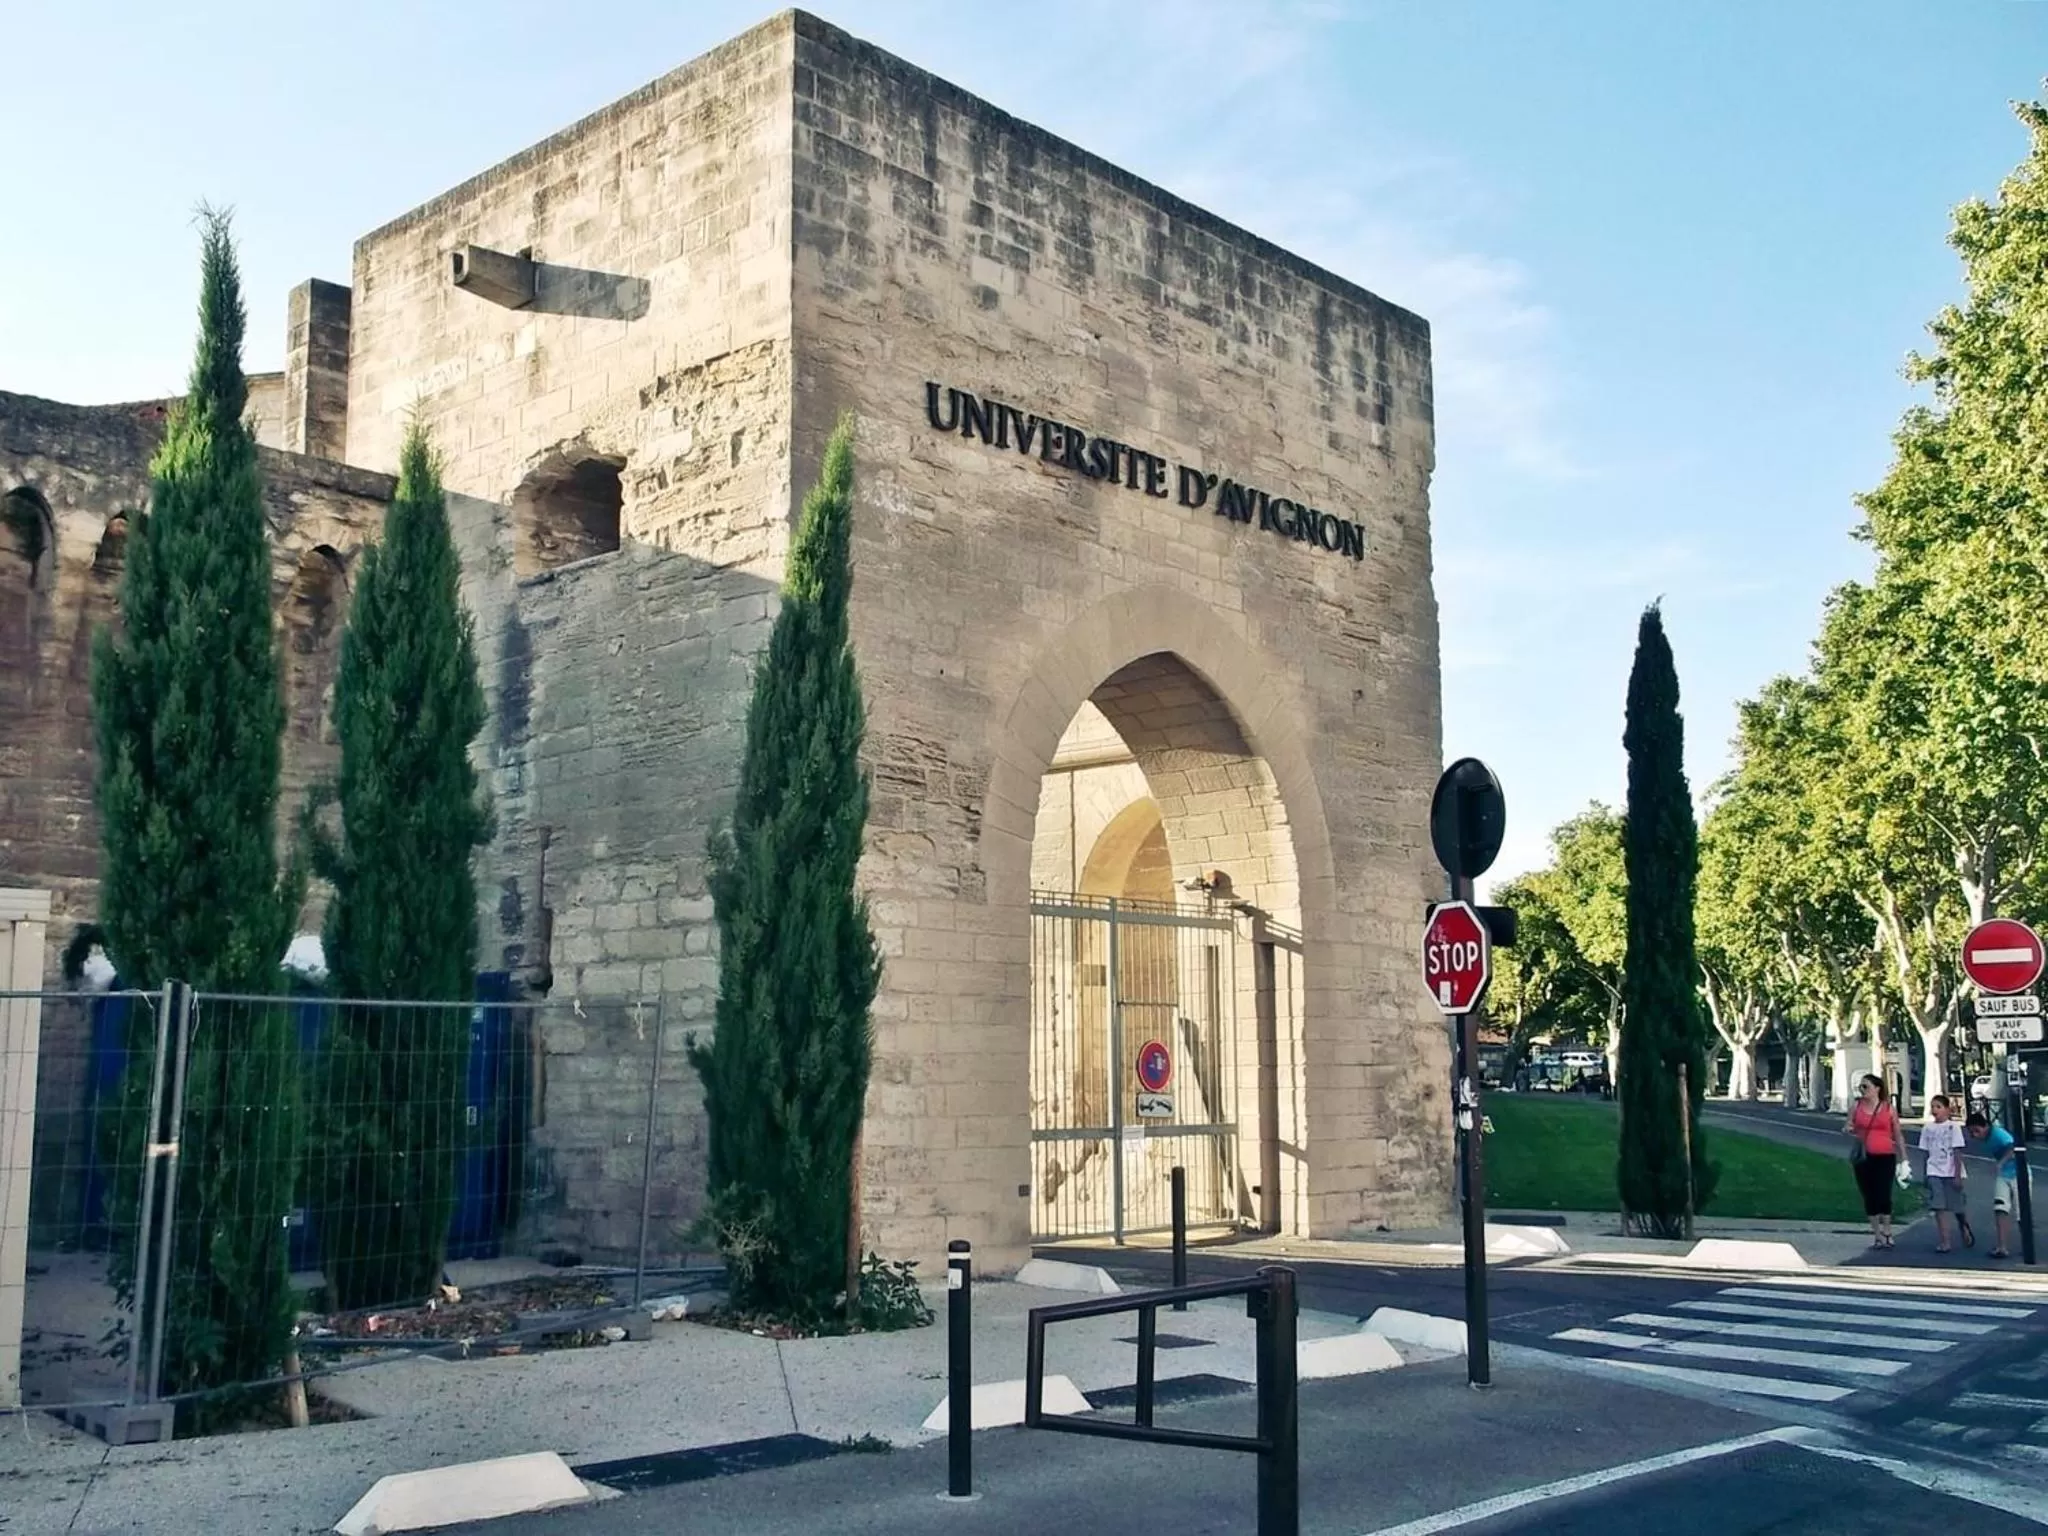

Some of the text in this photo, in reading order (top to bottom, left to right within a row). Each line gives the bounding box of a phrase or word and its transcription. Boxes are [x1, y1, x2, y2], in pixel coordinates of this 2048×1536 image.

[925, 381, 1168, 499] UNIVERSITE
[1429, 941, 1478, 974] STOP
[1979, 999, 2035, 1012] SAUF BUS
[1994, 1019, 2022, 1028] SAUF
